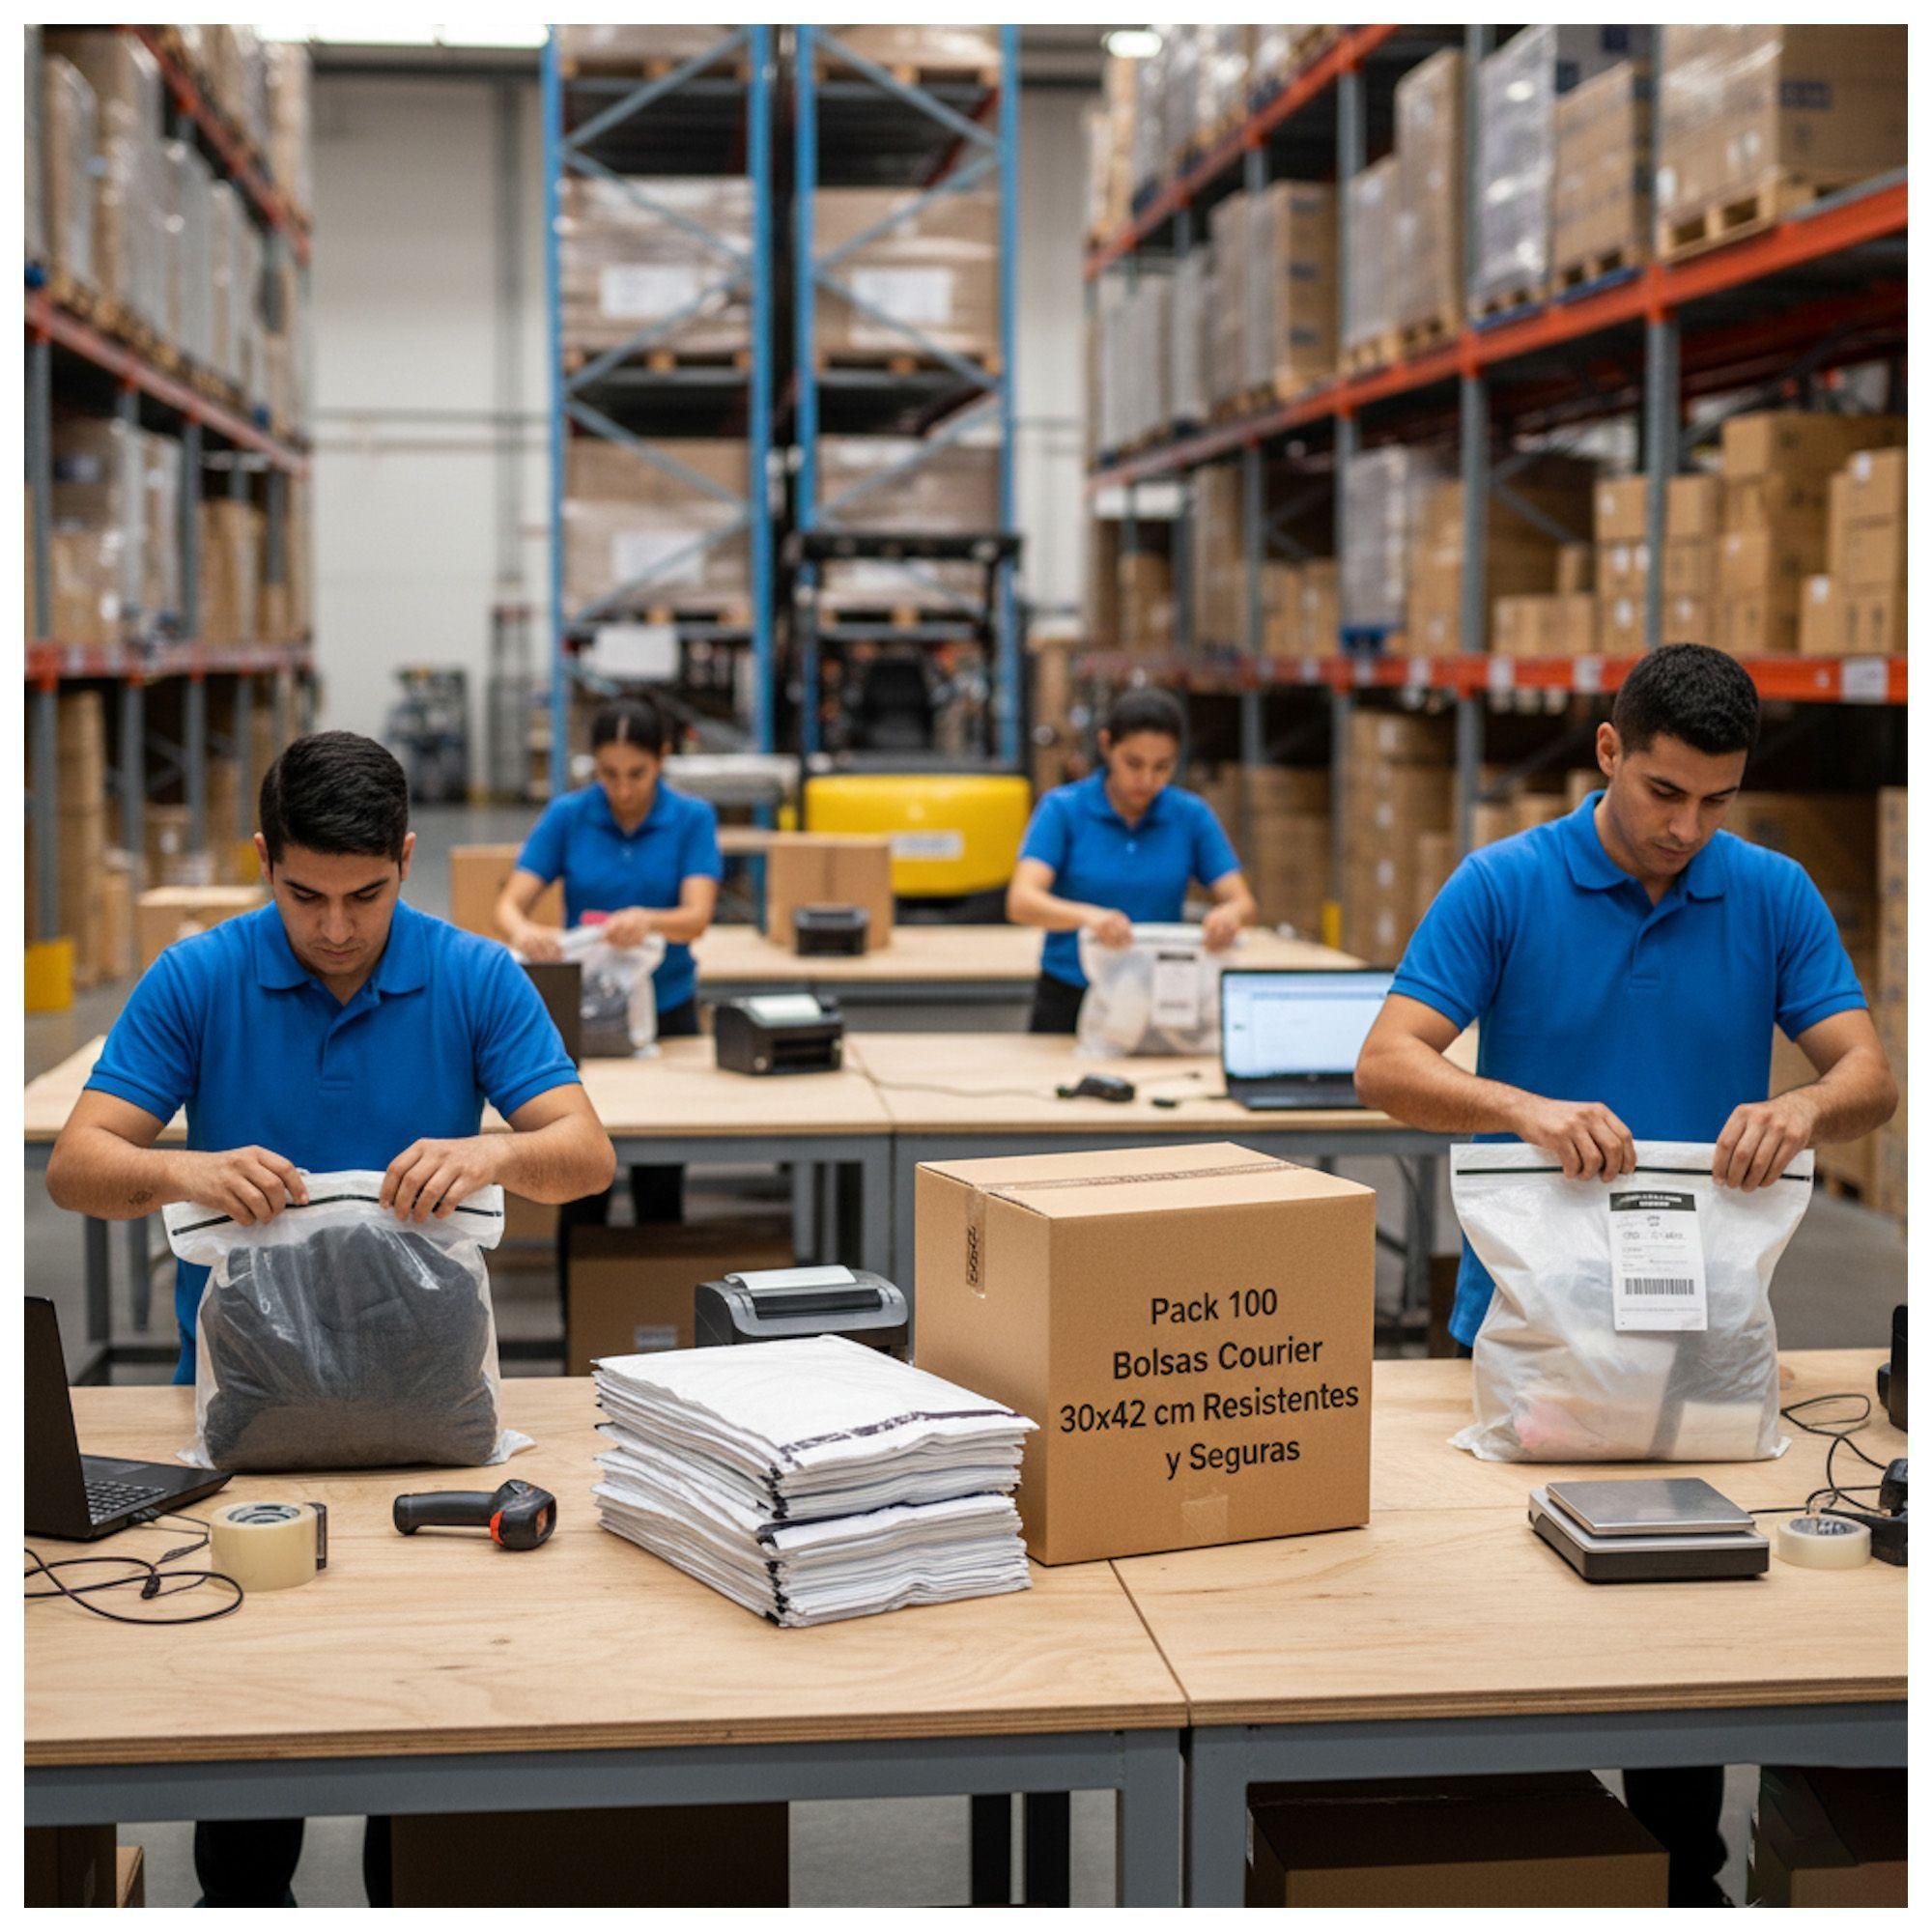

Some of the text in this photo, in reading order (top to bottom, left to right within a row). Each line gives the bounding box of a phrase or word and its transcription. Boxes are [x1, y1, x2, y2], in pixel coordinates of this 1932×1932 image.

[1151, 1288, 1278, 1325] Pack 100
[1113, 1335, 1323, 1380] Bolsas Courier
[1060, 1382, 1360, 1434] 30x42 cm Resistentes
[1165, 1439, 1301, 1481] y Seguras
